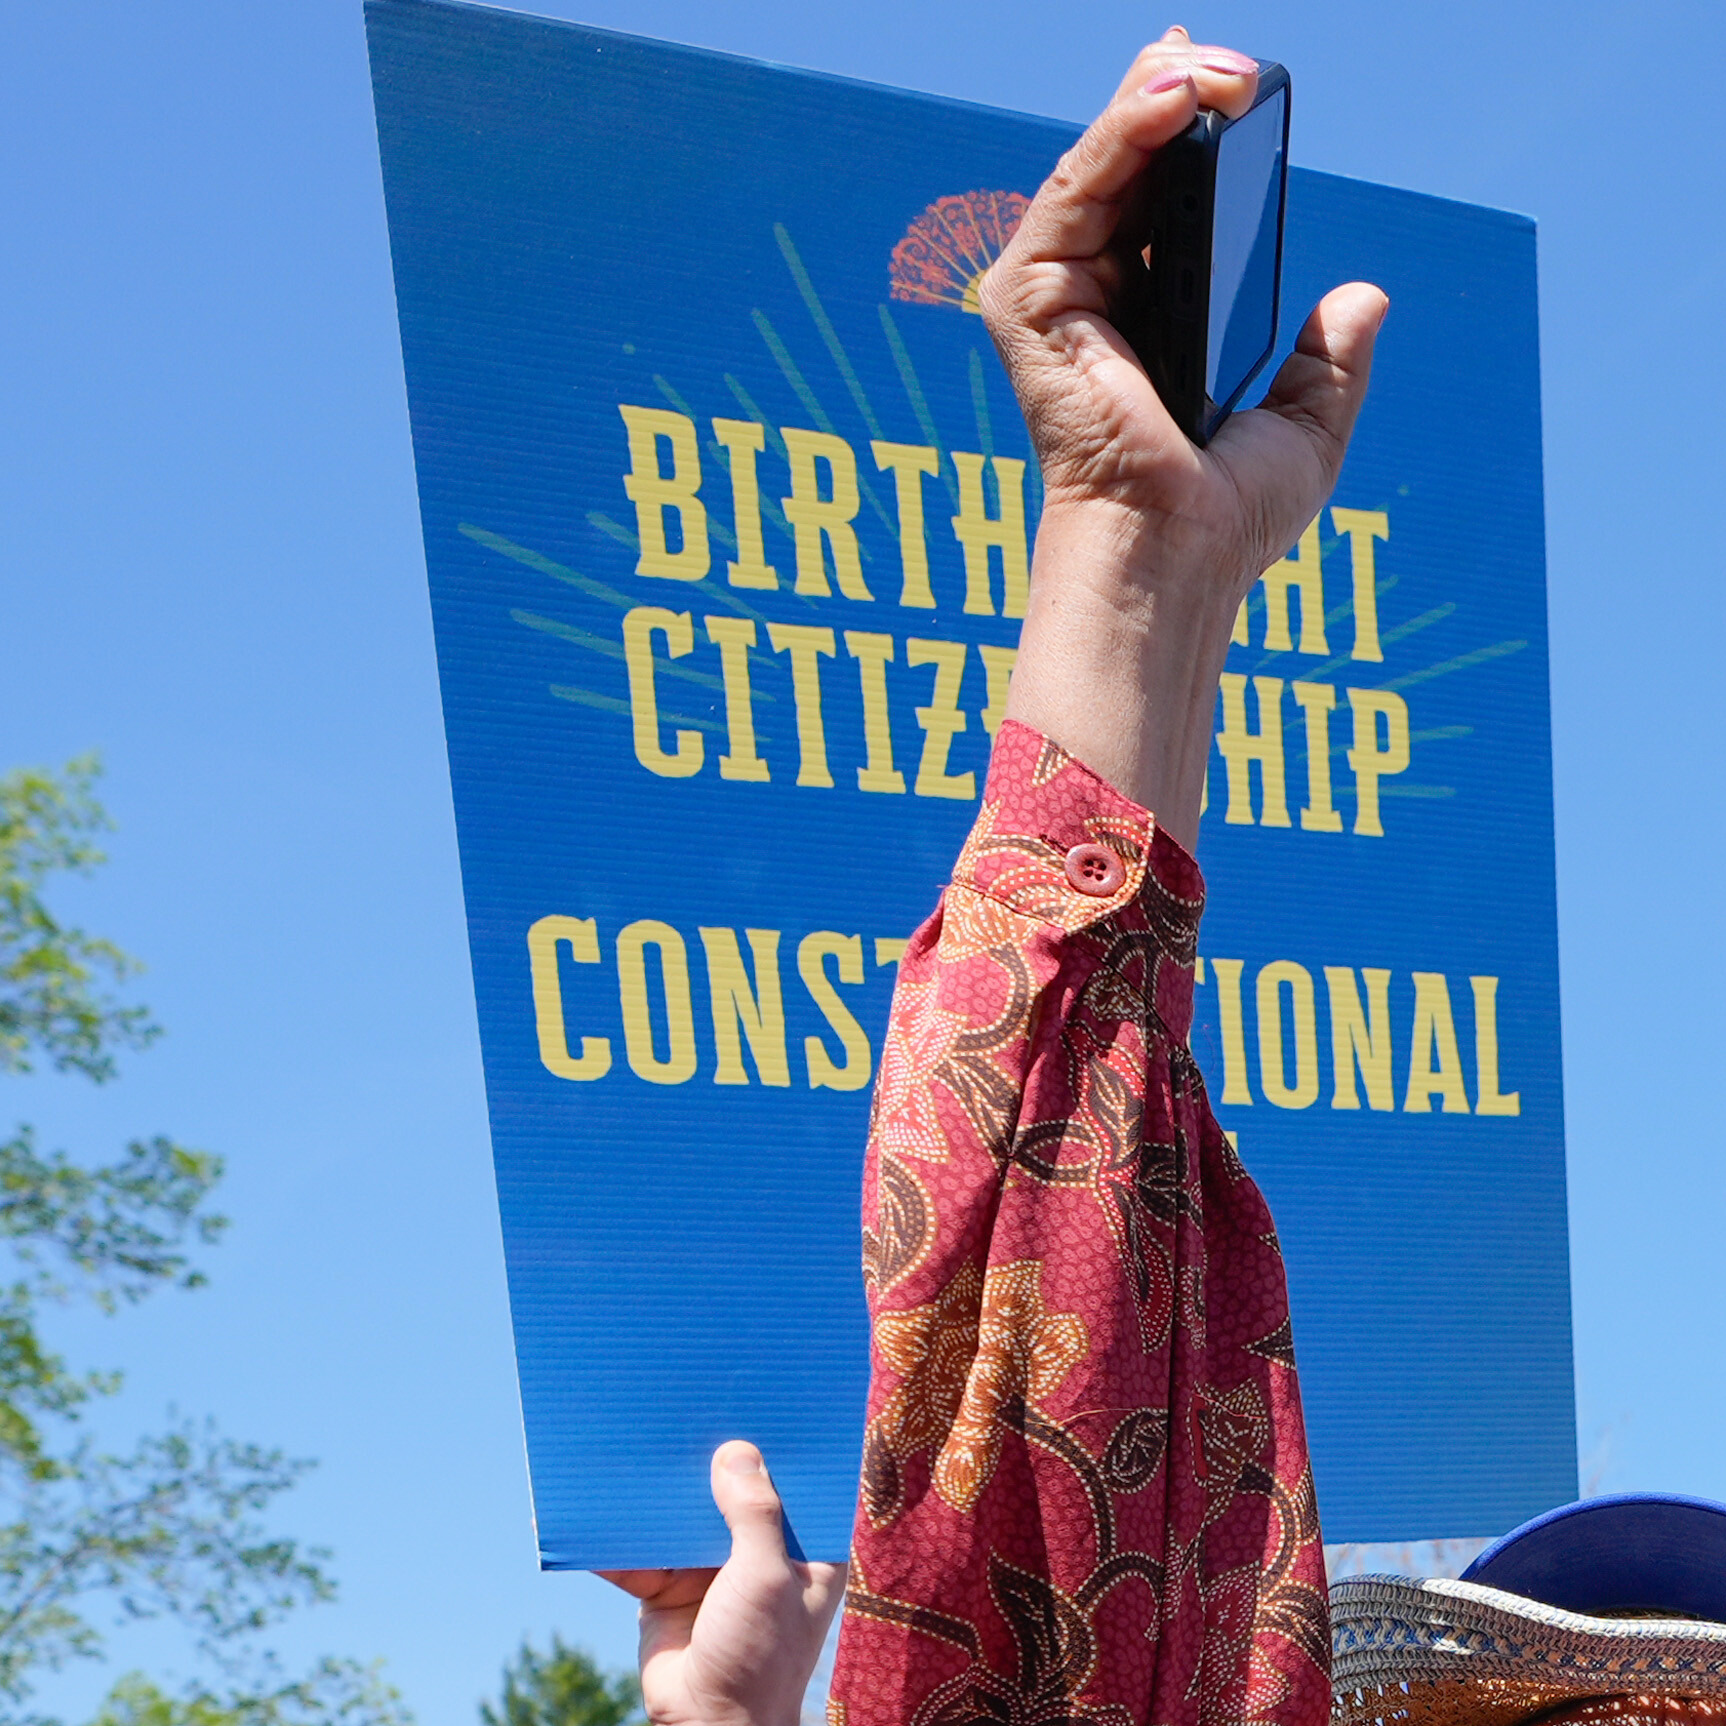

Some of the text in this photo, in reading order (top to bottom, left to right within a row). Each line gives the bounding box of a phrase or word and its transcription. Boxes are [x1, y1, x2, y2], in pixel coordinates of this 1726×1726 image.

[618, 404, 1389, 663] BIRTHHT
[622, 605, 1411, 838] CITIZHIP
[527, 914, 1521, 1117] CONSIONAL
